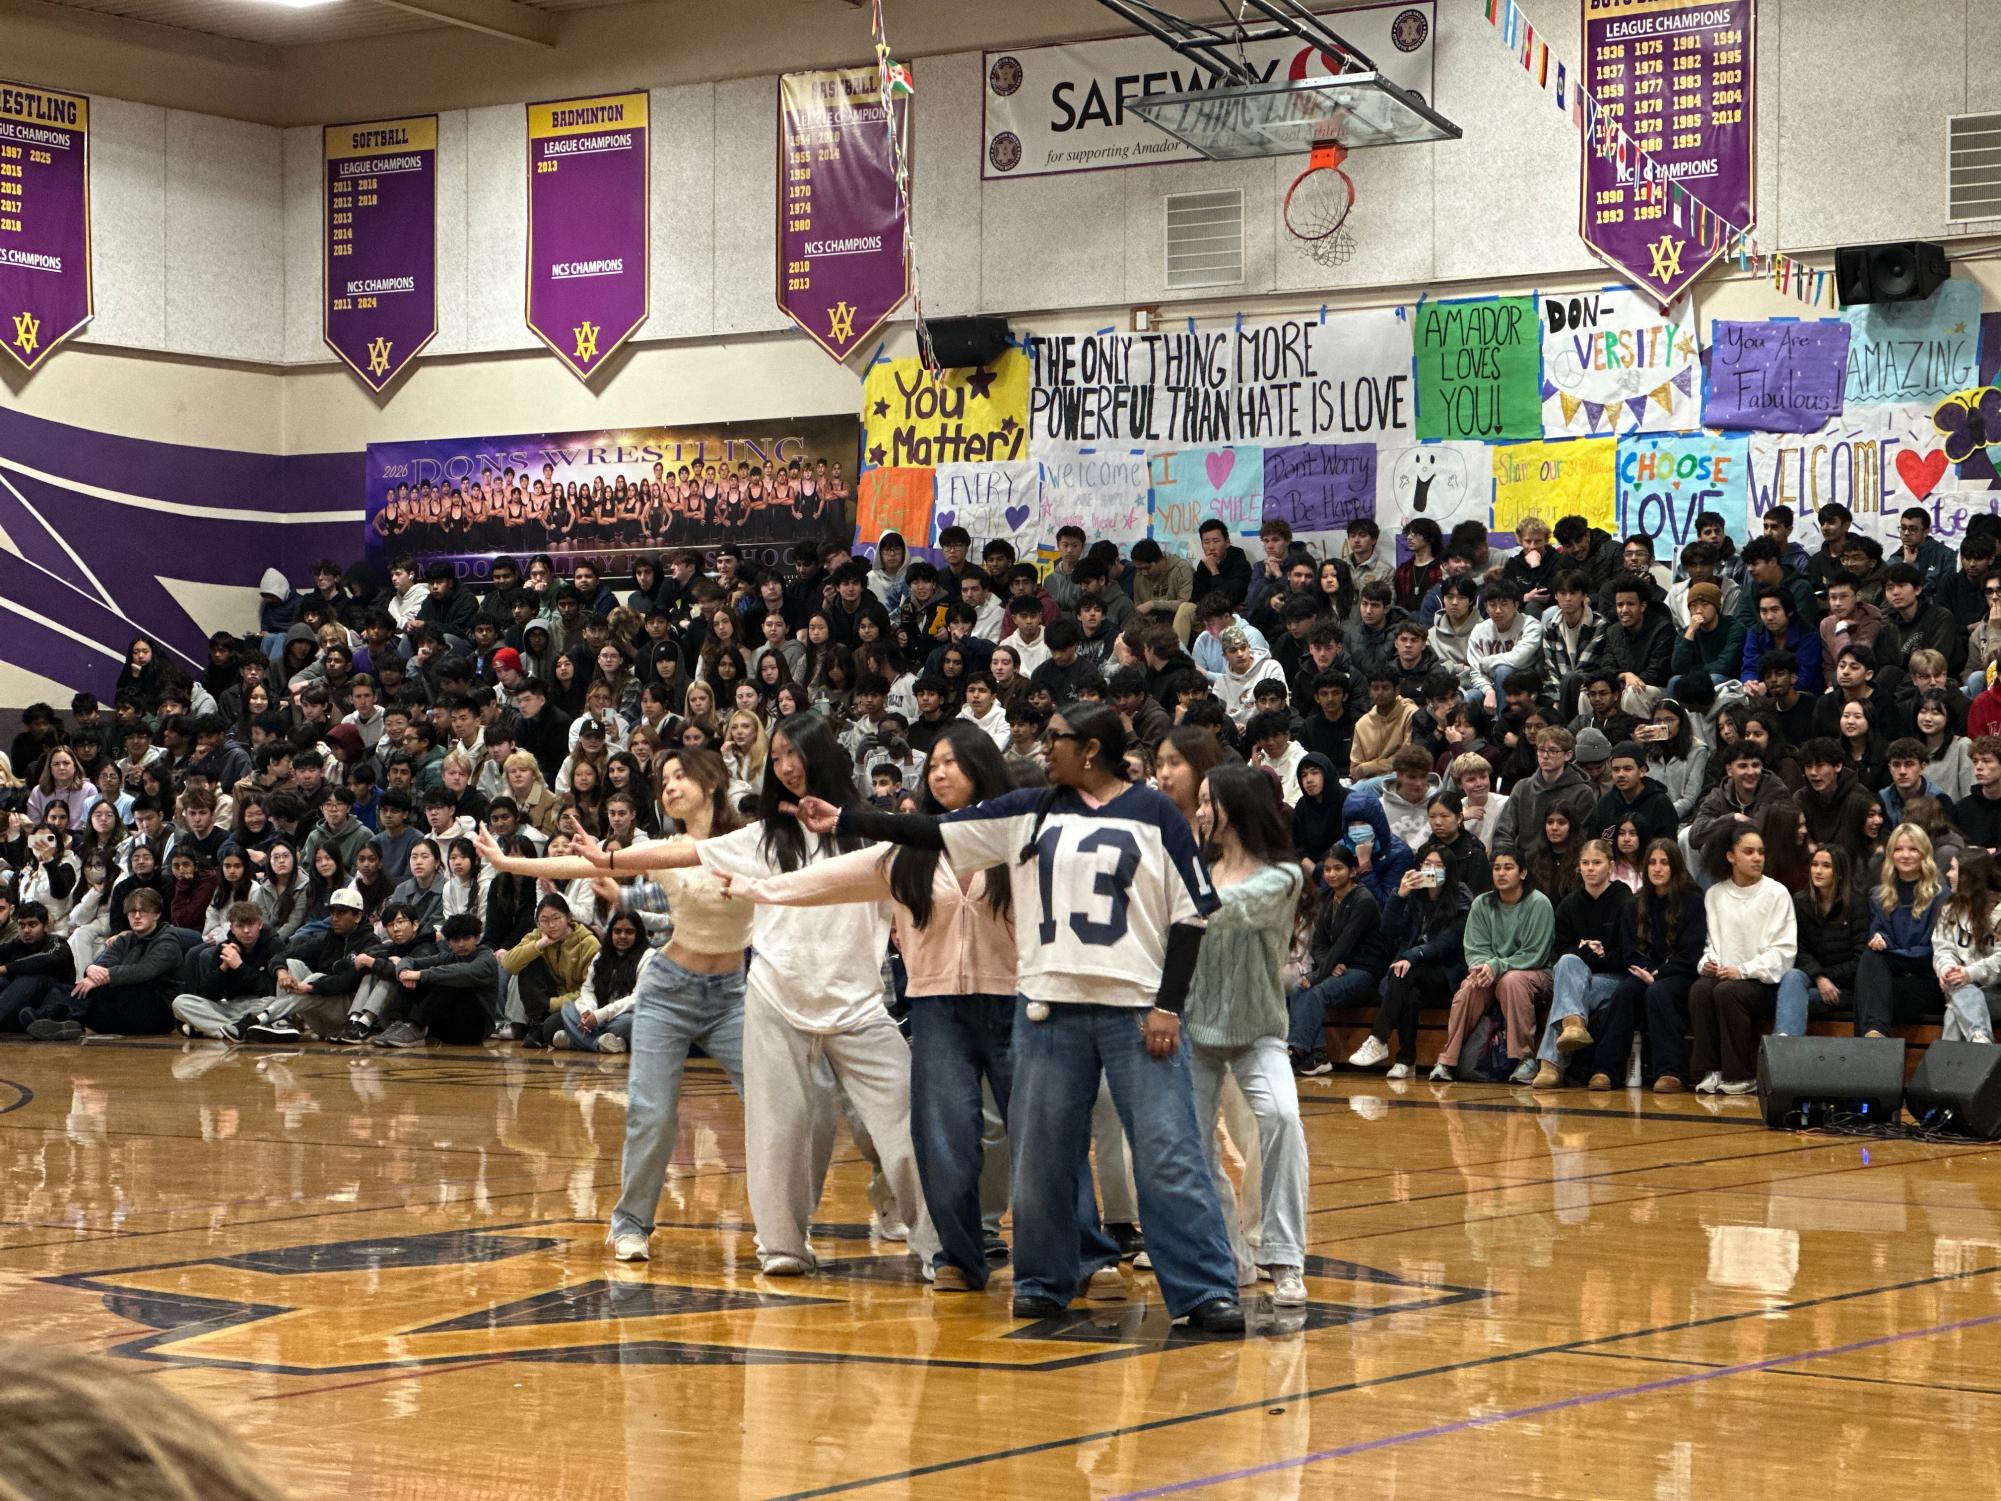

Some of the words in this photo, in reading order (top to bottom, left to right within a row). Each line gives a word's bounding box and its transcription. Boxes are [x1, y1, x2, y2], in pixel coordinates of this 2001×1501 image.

[1606, 19, 1653, 38] LEAGUE
[1655, 9, 1731, 31] CHAMPIONS
[1634, 40, 1663, 56] 1975
[1673, 35, 1701, 51] 1981
[1596, 64, 1625, 80] 1937
[1673, 54, 1701, 70] 1982
[1713, 49, 1742, 66] 1995
[1634, 79, 1663, 95] 1977
[1712, 69, 1742, 85] 2003
[0, 88, 77, 125] ESTLING
[1712, 89, 1742, 105] 2004
[552, 104, 624, 128] BADMINTON
[1634, 118, 1663, 134] 1979
[1712, 109, 1742, 125] 2018
[16, 126, 71, 147] CHAMPIONS
[352, 128, 409, 149] SOFTBALL
[544, 139, 578, 154] LEAGUE
[578, 134, 632, 150] CHAMPIONS
[30, 149, 51, 165] 2025
[1045, 150, 1064, 167] for
[1066, 144, 1129, 163] supporting
[1132, 138, 1181, 156] Amador
[1, 163, 22, 178] 2015
[340, 161, 371, 174] LEAGUE
[372, 156, 421, 171] CHAMPIONS
[537, 160, 558, 173] 2013
[1, 182, 22, 196] 2016
[333, 181, 352, 192] 2011
[1, 199, 22, 213] 2017
[333, 197, 352, 208] 2012
[1634, 205, 1662, 221] 1995
[1, 218, 22, 232] 2018
[333, 212, 352, 224] 2013
[333, 228, 352, 240] 2014
[804, 241, 823, 254] NCS
[825, 235, 881, 253] CHAMPIONS
[9, 250, 61, 269] CHAMPIONS
[333, 244, 352, 256] 2015
[552, 263, 569, 276] NCS
[571, 258, 623, 274] CHAMPIONS
[789, 260, 810, 273] 2010
[347, 281, 363, 293] NCS
[364, 276, 414, 292] CHAMPIONS
[789, 278, 810, 290] 2013
[333, 298, 352, 310] 2011
[358, 297, 377, 309] 2024
[1546, 295, 1615, 334] DON-
[1425, 305, 1522, 348] AMADOR
[1031, 335, 1076, 387] THE
[1082, 335, 1133, 387] ONLY
[1141, 333, 1227, 390] THING
[1237, 321, 1319, 385] MORE
[1574, 323, 1680, 370] VERSITY
[1722, 327, 1765, 366] You
[1775, 326, 1811, 362] Are
[1441, 346, 1501, 382] LOVES
[1846, 340, 1972, 395] AMAZING
[894, 368, 965, 420] You
[1733, 368, 1841, 412] Fabulous!
[1030, 385, 1160, 441] POWERFUL
[1168, 386, 1232, 442] THAN
[1237, 381, 1303, 441] HATE
[1311, 379, 1334, 434] IS
[1340, 375, 1408, 433] LOVE
[1439, 385, 1504, 436] YOU!
[382, 464, 409, 479] 2026
[412, 451, 529, 486] DONS
[542, 436, 808, 468] WRESTLING
[1319, 446, 1370, 492] Worry
[1621, 452, 1732, 483] CHOOSE
[951, 471, 1014, 505] EVERY
[1747, 437, 1900, 518] WELCOME
[1157, 501, 1201, 536] YOUR
[1209, 493, 1262, 523] SMILE
[1290, 489, 1315, 522] Be
[1322, 484, 1374, 521] Happy
[1035, 825, 1142, 947] 13
